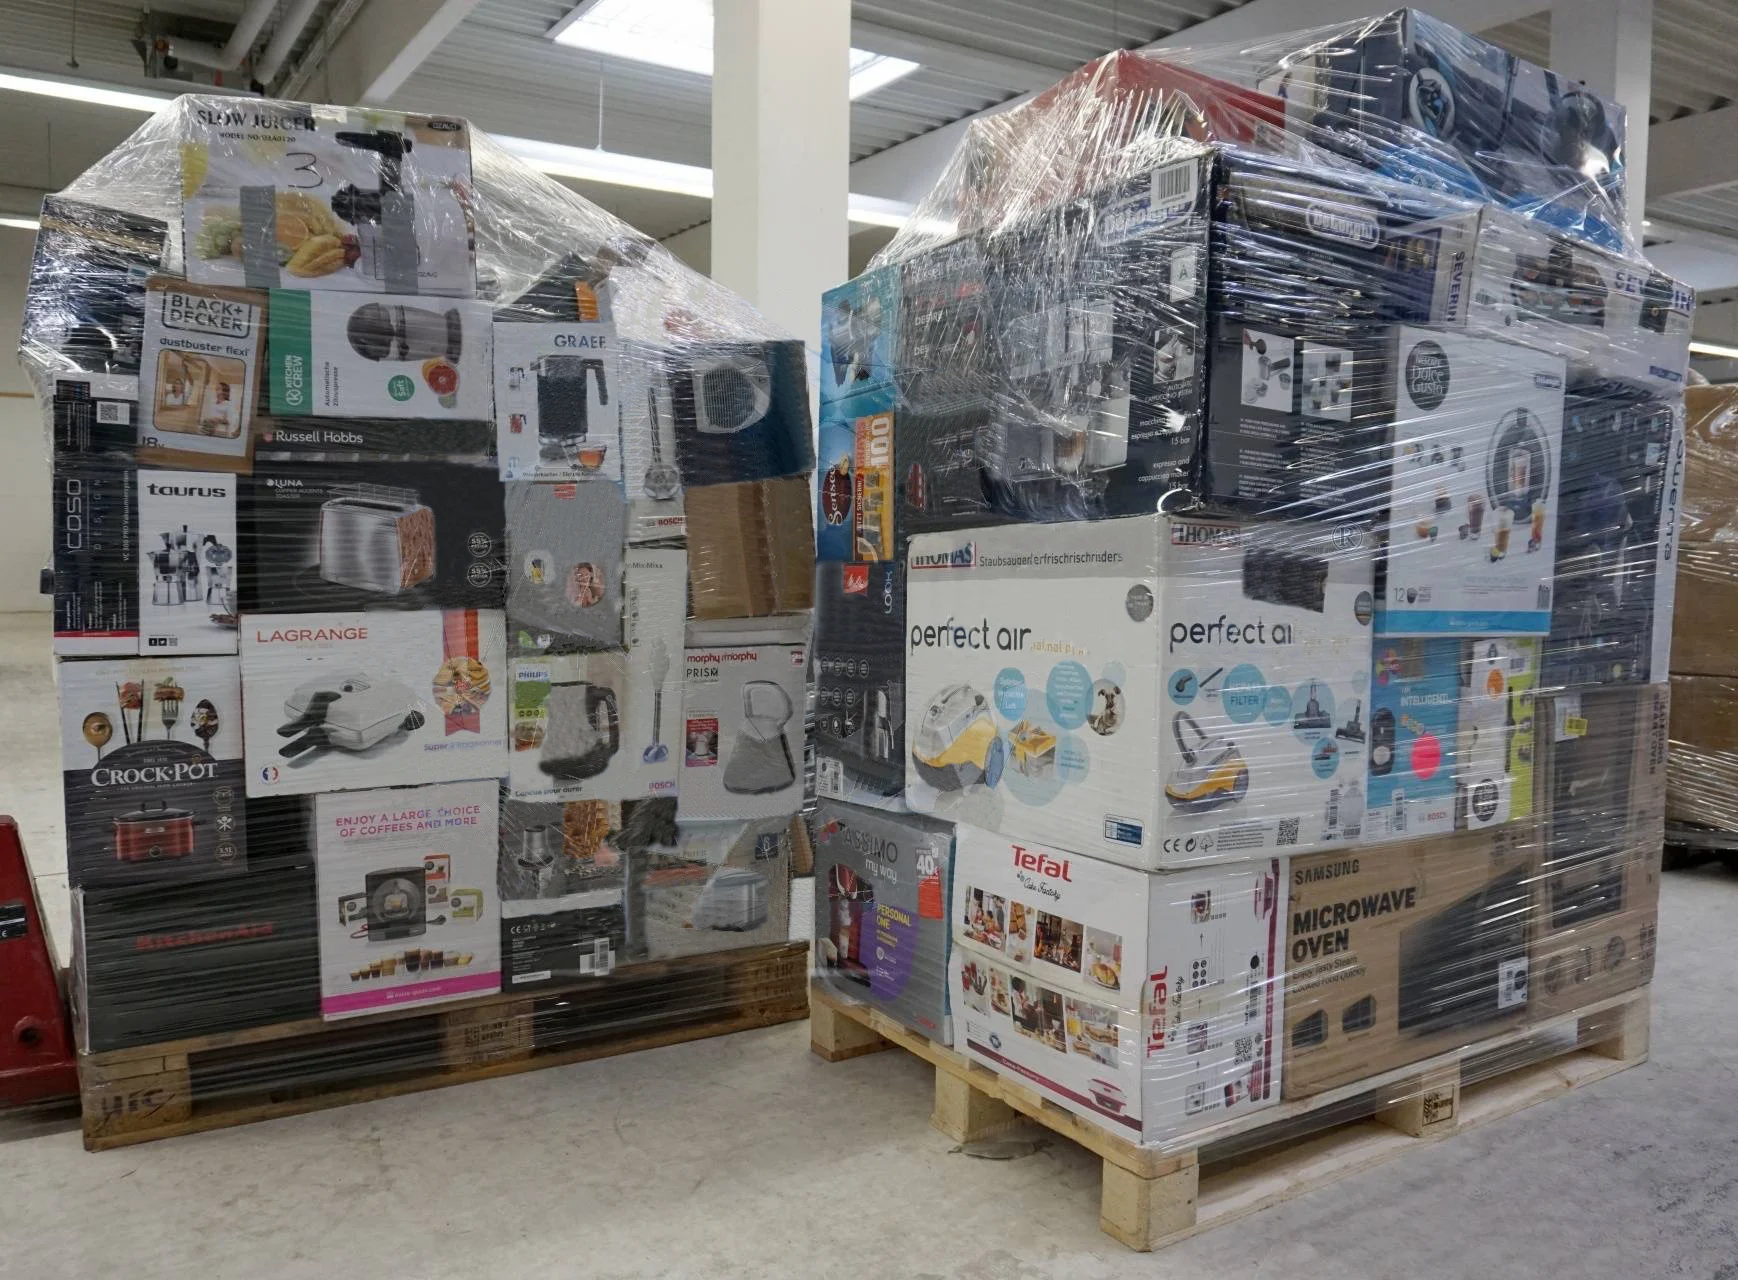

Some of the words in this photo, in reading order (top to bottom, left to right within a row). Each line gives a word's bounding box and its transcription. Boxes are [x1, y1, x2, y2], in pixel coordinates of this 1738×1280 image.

[252, 113, 316, 132] JUICER
[286, 152, 324, 189] 3
[170, 308, 244, 332] DECKER
[160, 336, 222, 354] dustbuster
[275, 430, 320, 443] Russell
[324, 430, 364, 445] Hobbs
[147, 482, 226, 498] taurus
[275, 479, 304, 488] LUNA
[256, 628, 368, 644] LAGRANGE
[911, 616, 990, 656] perfect
[1170, 614, 1266, 654] perfect
[686, 668, 718, 678] PRISM
[1230, 695, 1260, 706] FILTER
[335, 814, 376, 828] ENJOY
[380, 814, 389, 824] A
[392, 808, 432, 822] LARGE
[436, 804, 482, 818] CHOICE
[340, 826, 356, 838] OF
[359, 822, 414, 837] COFFEES
[416, 819, 442, 831] AND
[444, 816, 478, 828] MORE
[1012, 844, 1073, 883] Tefal
[1294, 858, 1360, 886] SAMSUNG
[877, 904, 912, 927] PERSONAL
[1292, 886, 1417, 936] MICROWAVE
[1292, 928, 1350, 963] OVEN
[1147, 966, 1168, 1059] Tefal
